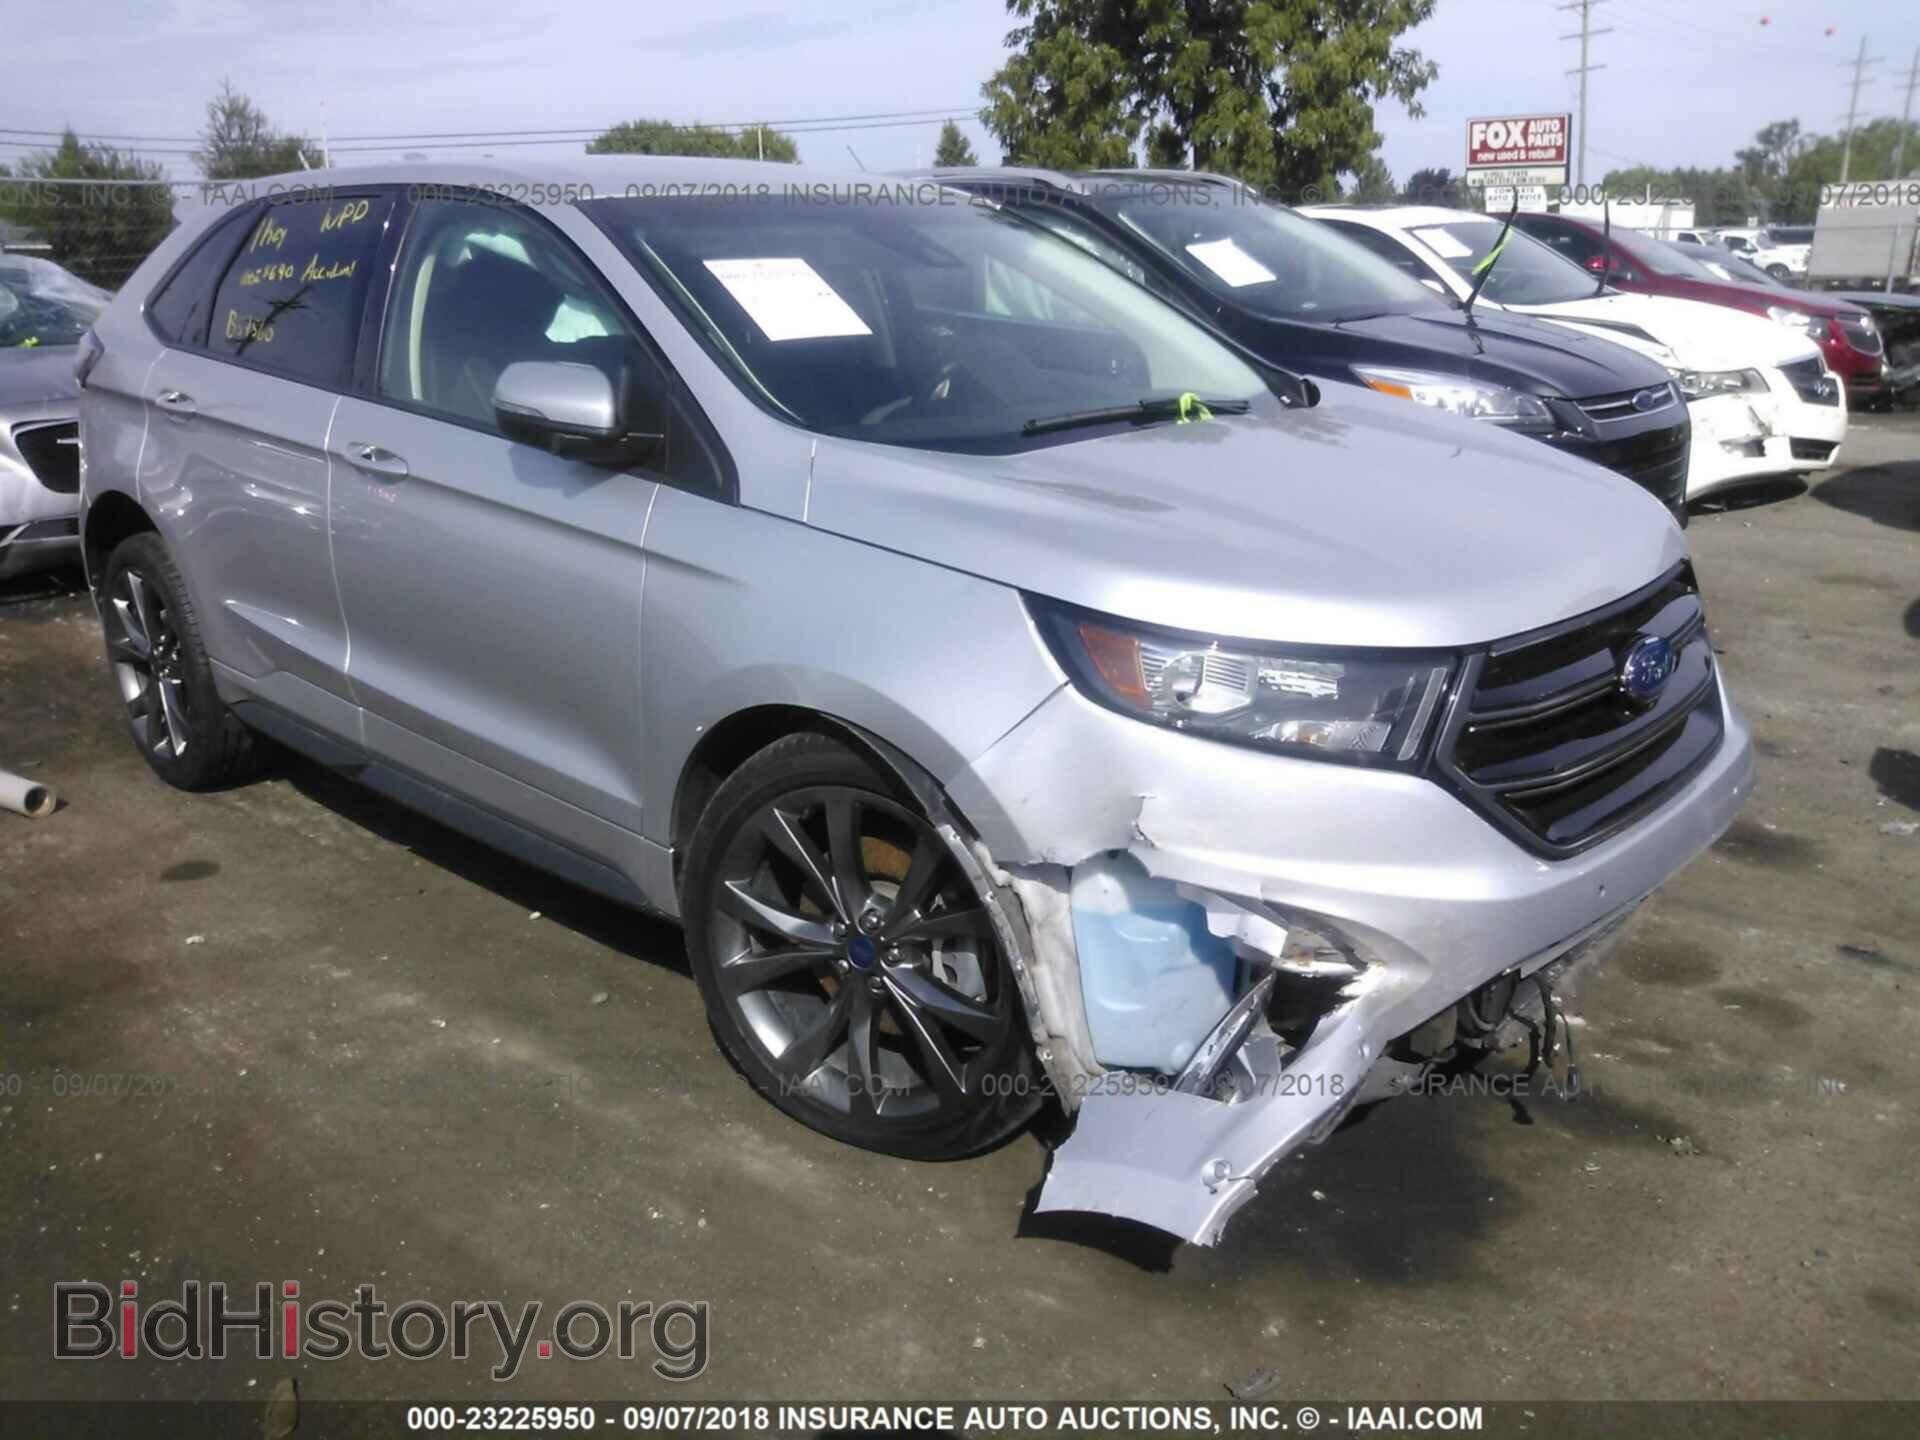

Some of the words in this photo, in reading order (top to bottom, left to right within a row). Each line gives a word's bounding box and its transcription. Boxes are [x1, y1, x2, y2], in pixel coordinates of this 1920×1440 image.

[1528, 119, 1560, 133] AUTO
[1472, 121, 1526, 149] FOX
[1528, 132, 1562, 147] PARTS
